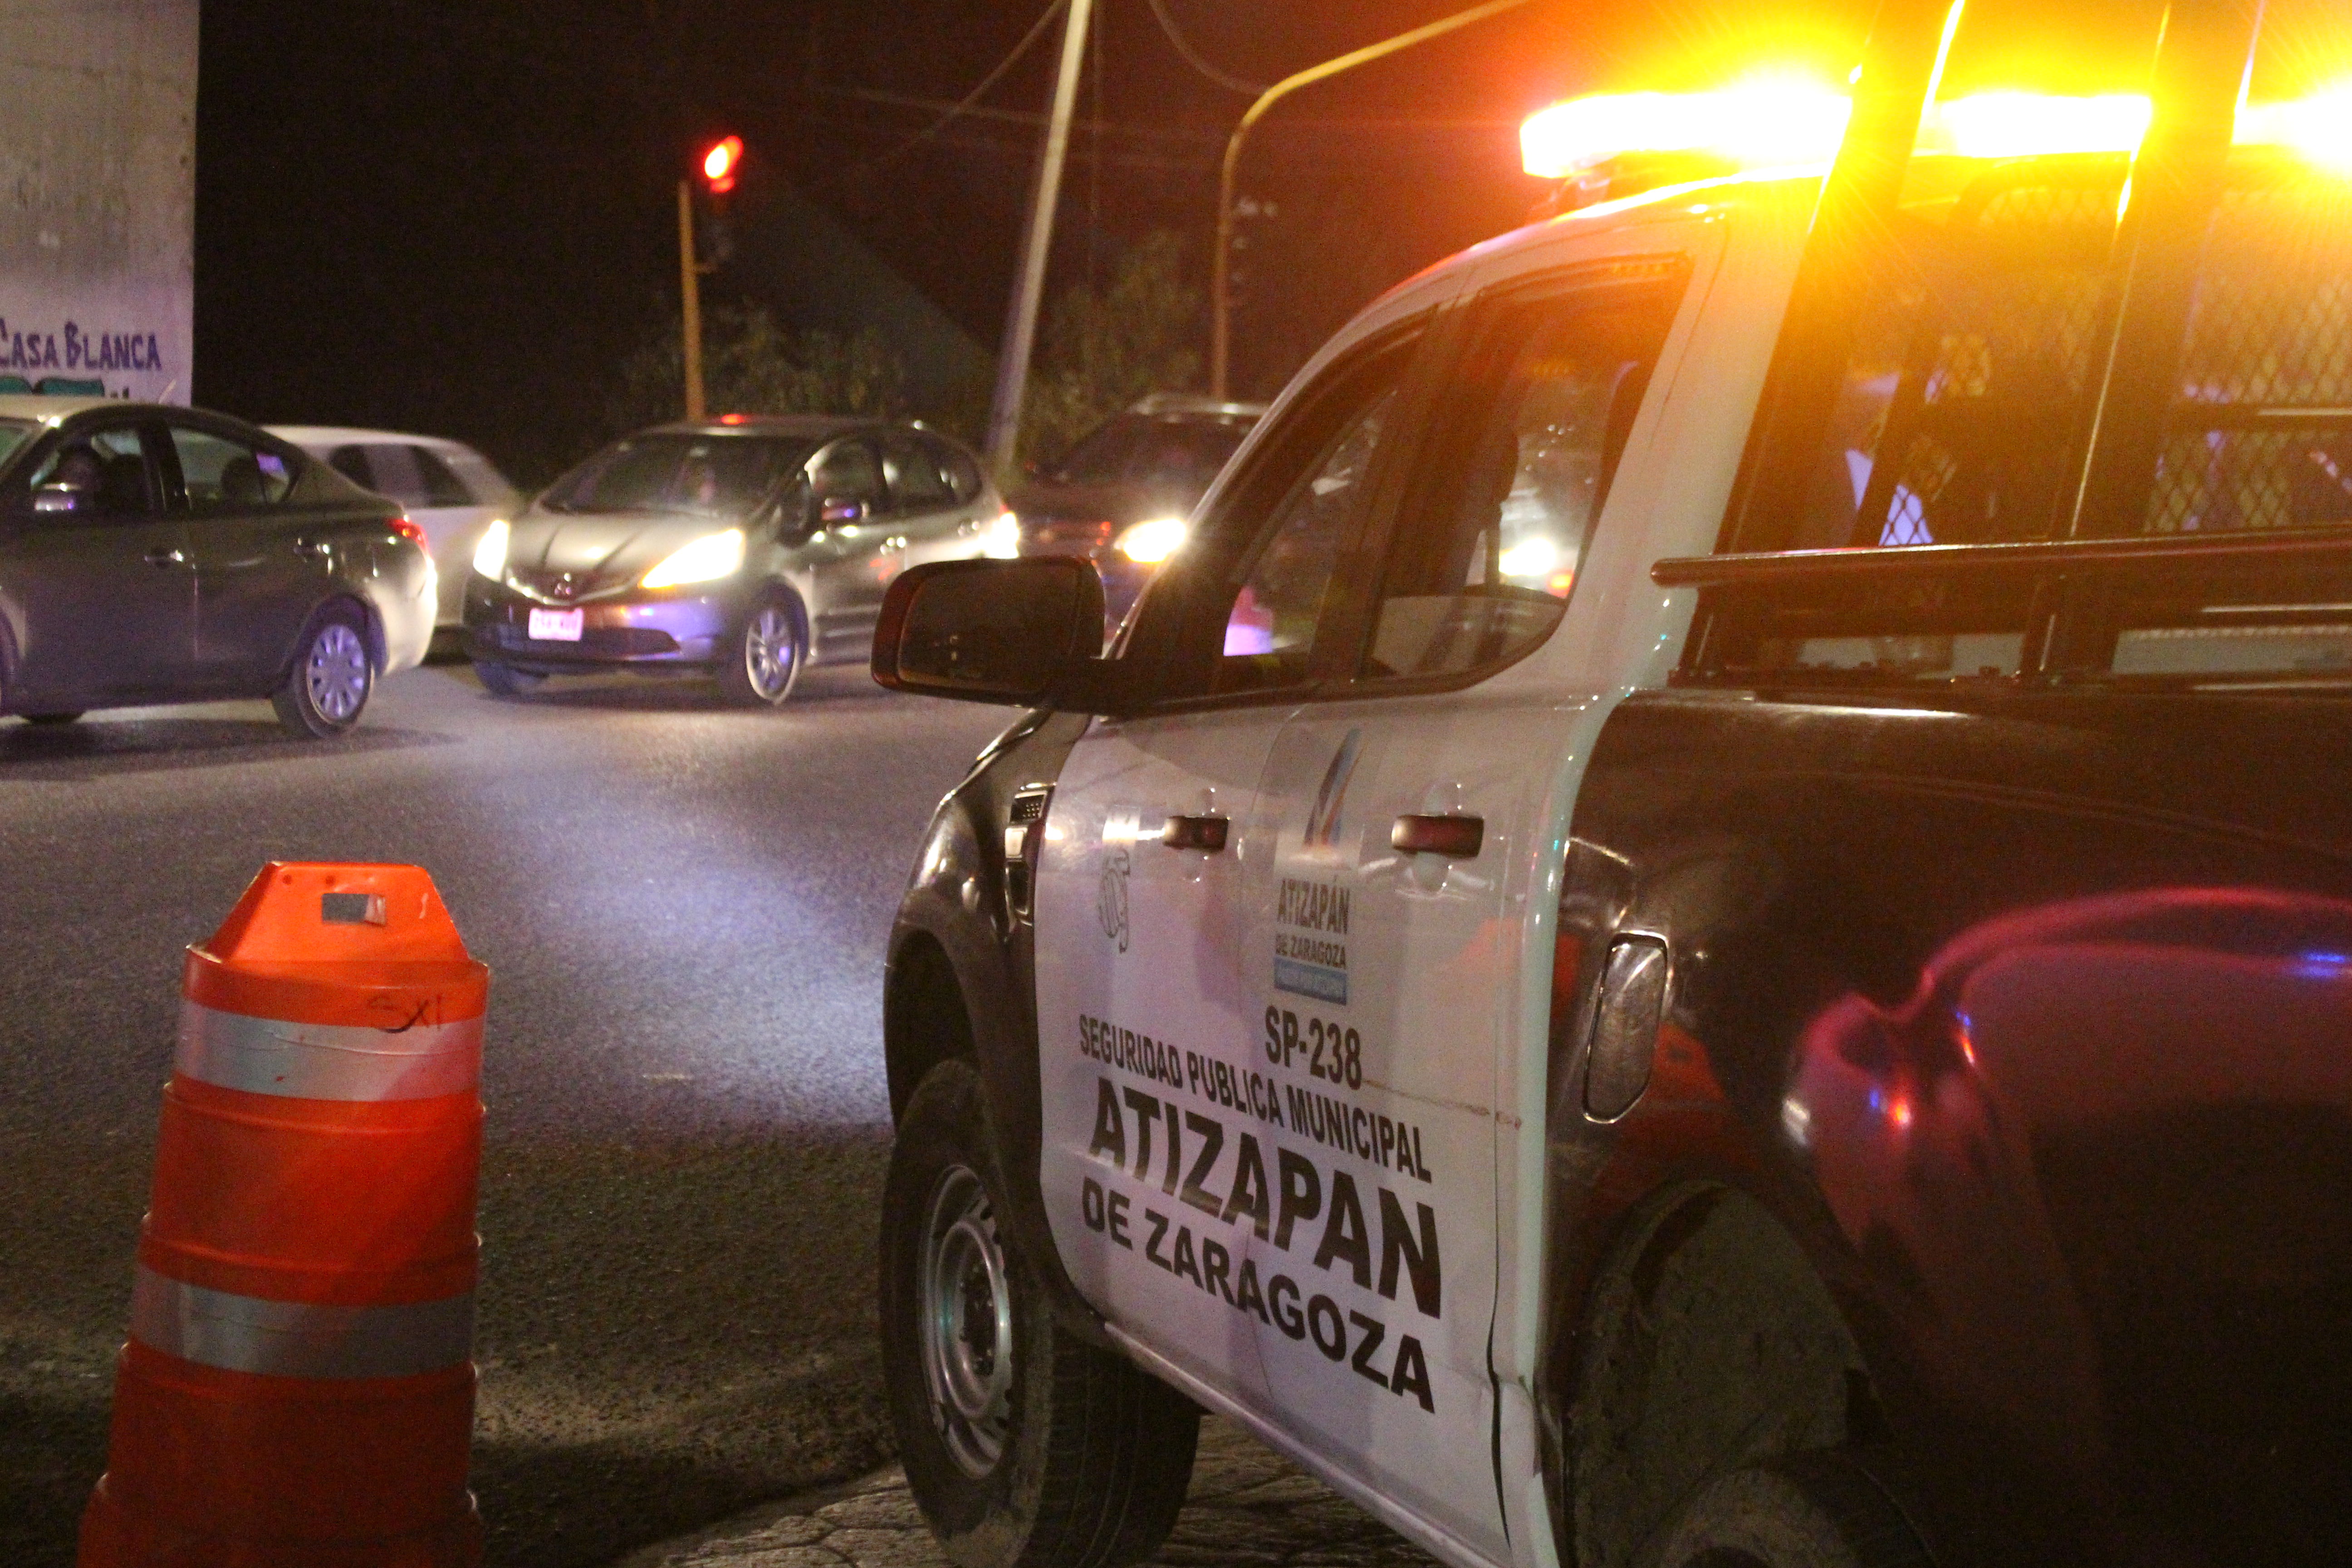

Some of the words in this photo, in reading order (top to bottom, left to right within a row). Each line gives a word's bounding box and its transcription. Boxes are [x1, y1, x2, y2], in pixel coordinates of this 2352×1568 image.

[64, 320, 162, 370] BLANCA
[1290, 934, 1346, 970] ZARAGOZA
[1079, 1014, 1183, 1089] SEGURIDAD
[1187, 1051, 1285, 1128] PUBLICA
[1286, 1084, 1432, 1184] MUNICIPAL
[1265, 1005, 1362, 1090] SP-238
[1090, 1077, 1441, 1319] ATIZAPAN
[1083, 1176, 1132, 1251] DE
[1145, 1207, 1435, 1414] ZARAGOZA
